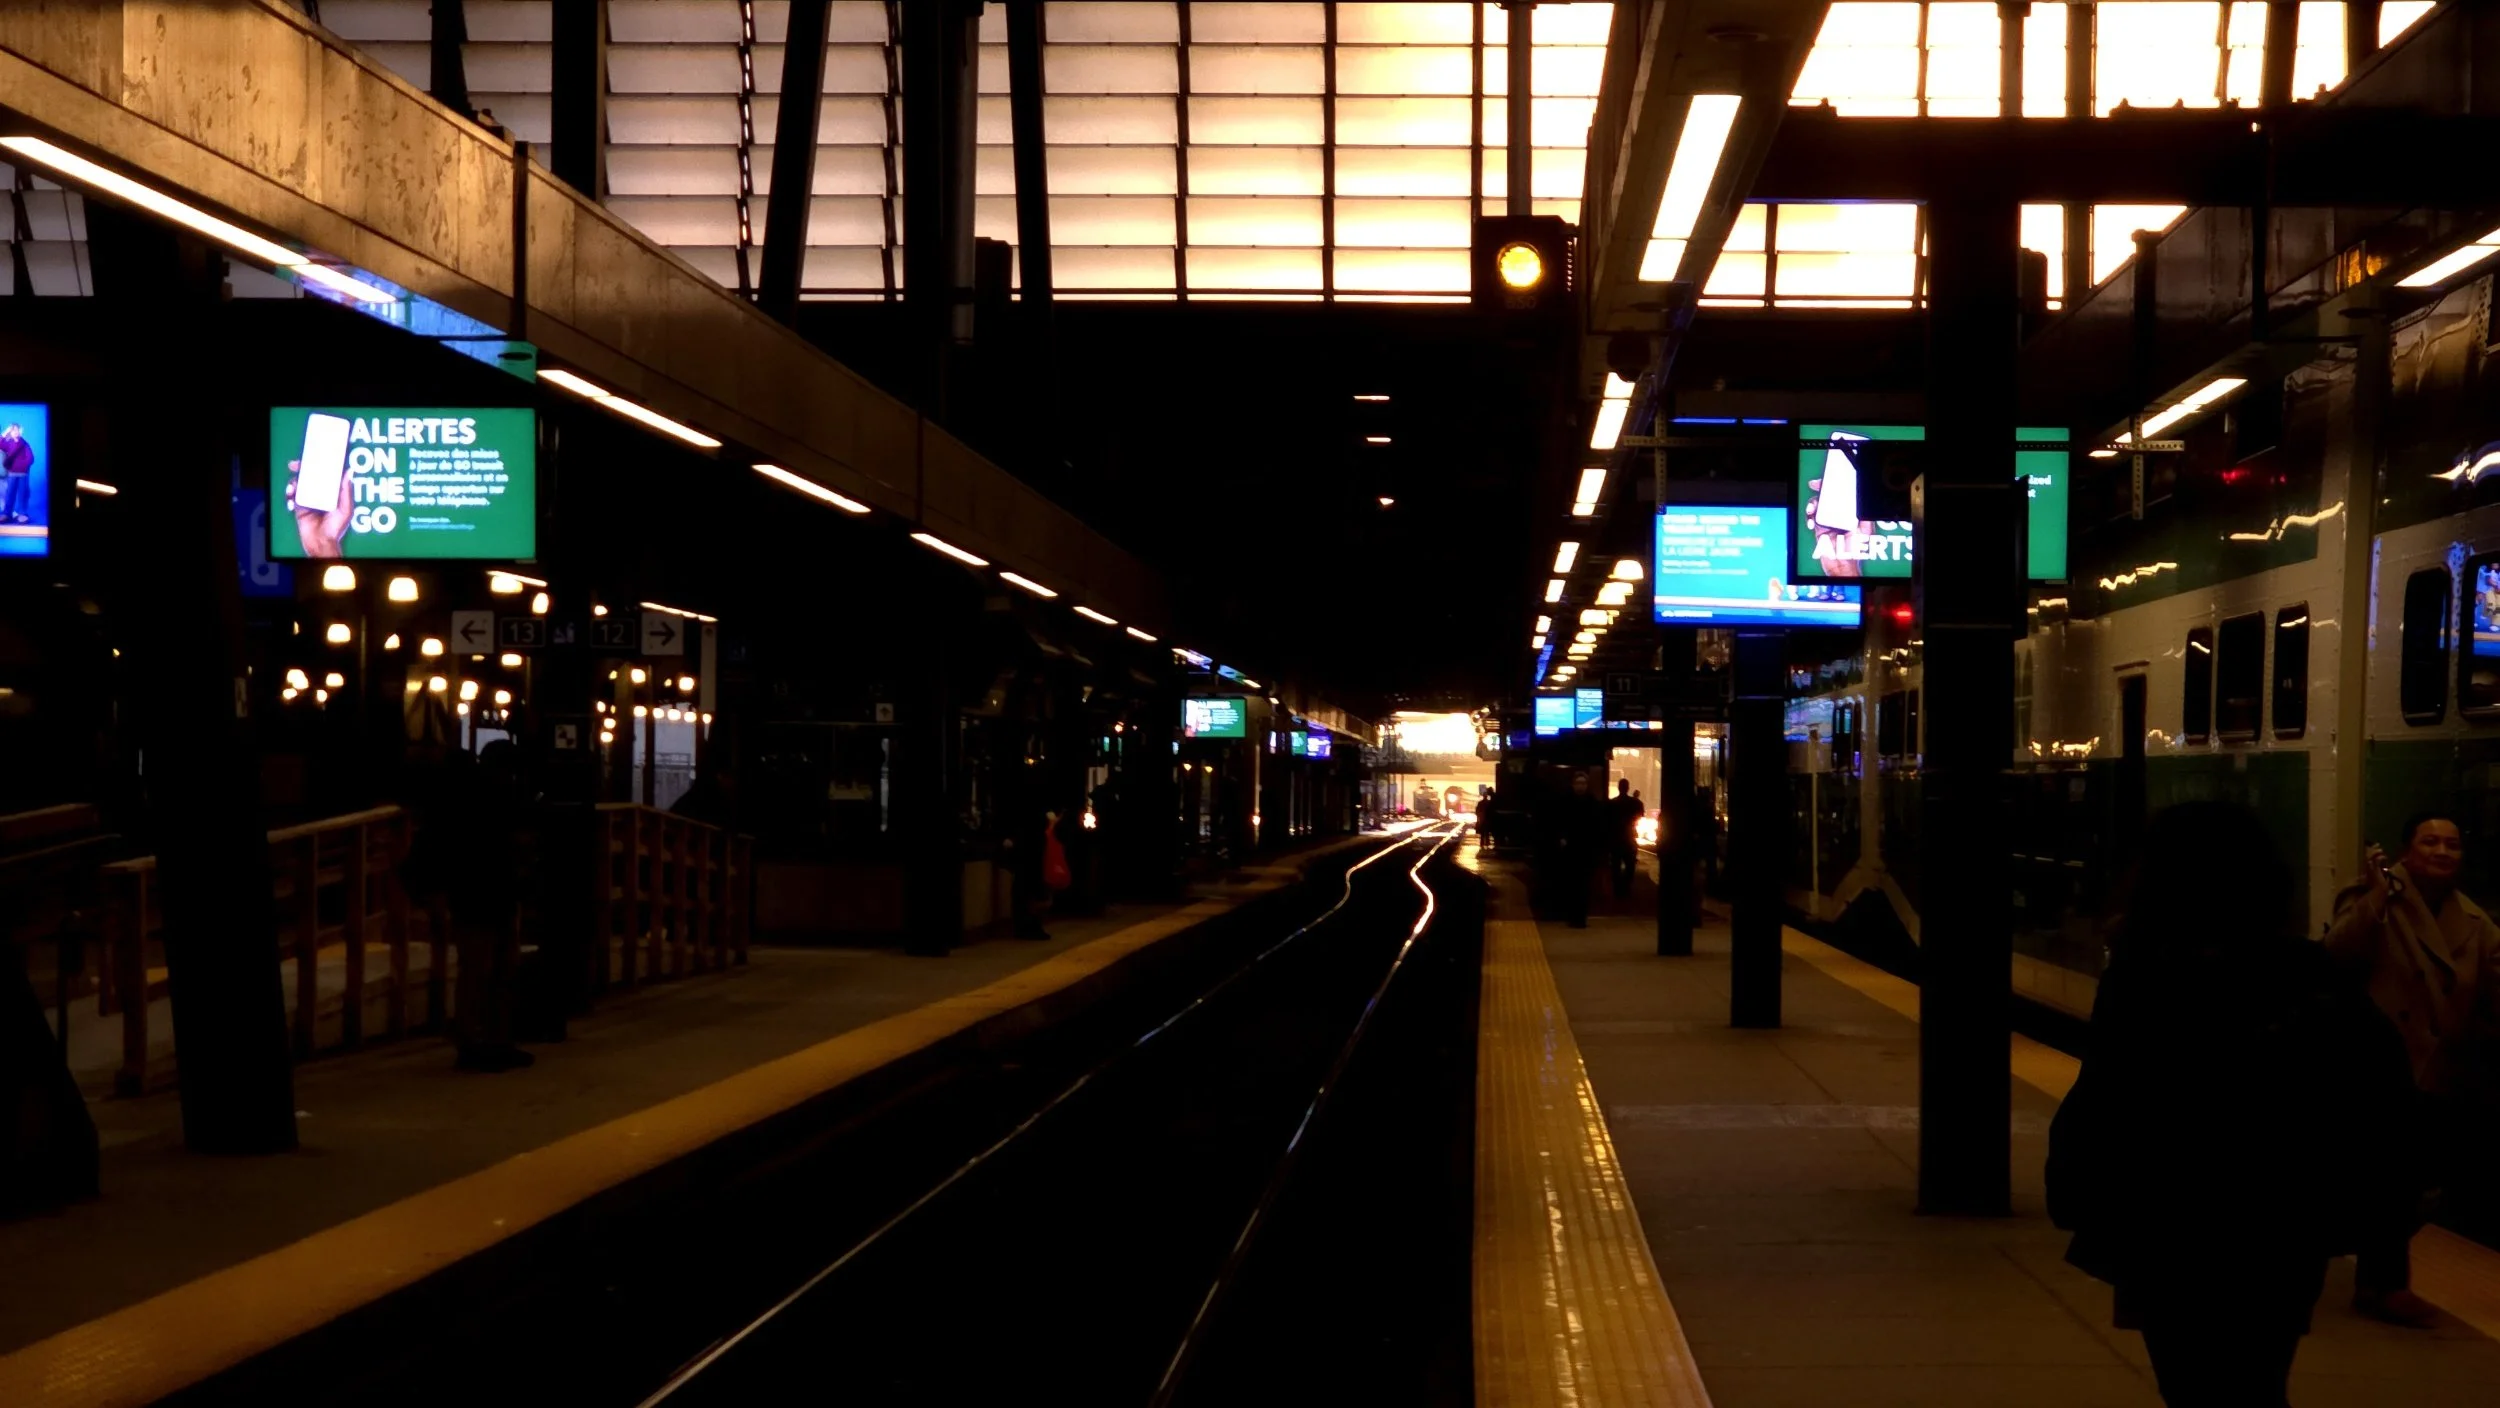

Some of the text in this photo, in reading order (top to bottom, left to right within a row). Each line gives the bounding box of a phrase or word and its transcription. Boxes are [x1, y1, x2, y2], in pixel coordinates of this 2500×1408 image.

[350, 417, 476, 444] ALERTES
[349, 447, 396, 473] ON
[417, 460, 438, 472] jour
[453, 460, 471, 470] GO
[352, 477, 405, 503] THE
[351, 506, 397, 533] GO
[509, 621, 535, 644] 13
[600, 622, 626, 644] 12
[1615, 677, 1631, 692] 11
